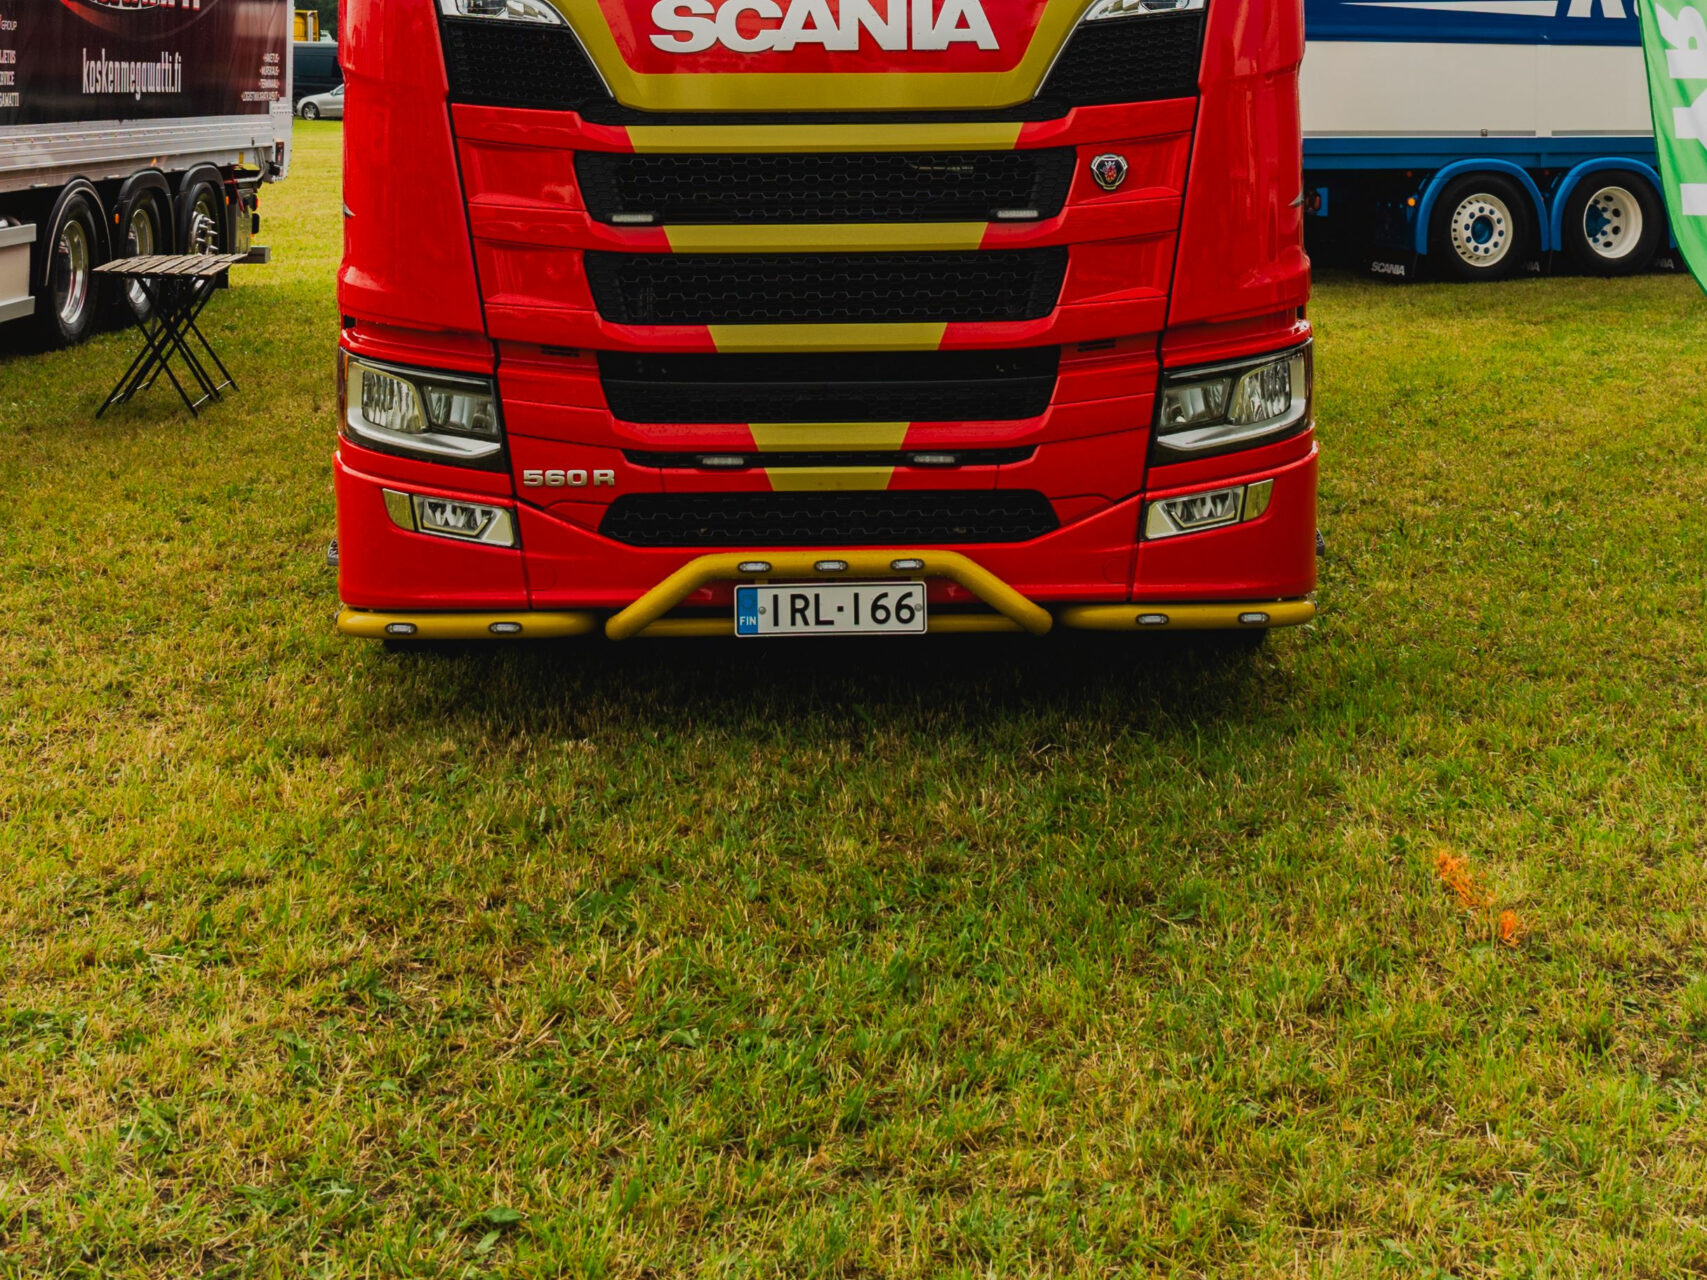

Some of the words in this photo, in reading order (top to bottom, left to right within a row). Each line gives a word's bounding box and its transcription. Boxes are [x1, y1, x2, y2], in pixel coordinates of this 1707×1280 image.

[82, 47, 182, 101] koskenmegawatti.fi
[1371, 261, 1406, 276] SCANIA
[523, 469, 588, 487] 560
[593, 469, 616, 487] R
[738, 615, 758, 626] FIN
[772, 591, 916, 628] IRL-166
